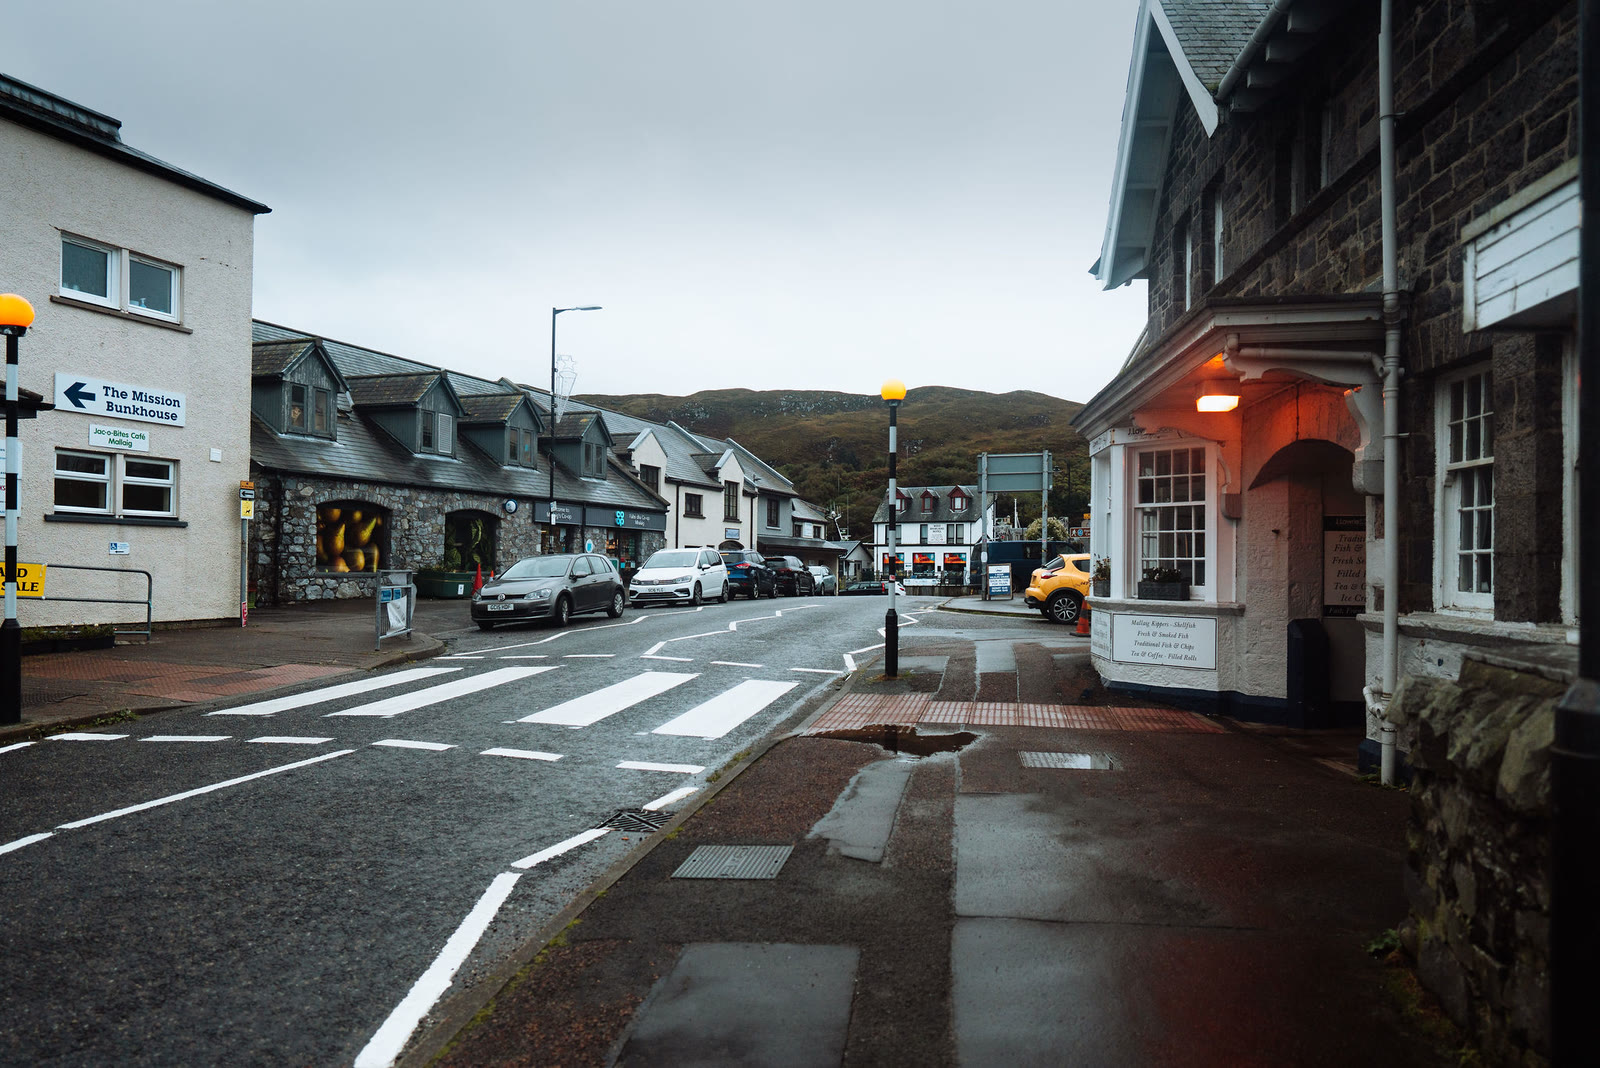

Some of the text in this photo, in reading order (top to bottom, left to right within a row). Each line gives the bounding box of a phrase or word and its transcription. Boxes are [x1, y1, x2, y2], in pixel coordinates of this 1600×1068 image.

[103, 386, 180, 408] The Mission
[106, 401, 178, 420] Bunkhouse
[130, 432, 146, 440] Café
[108, 438, 132, 448] Mallaig
[1332, 556, 1354, 564] Fresh
[1174, 621, 1196, 630] Shellfish
